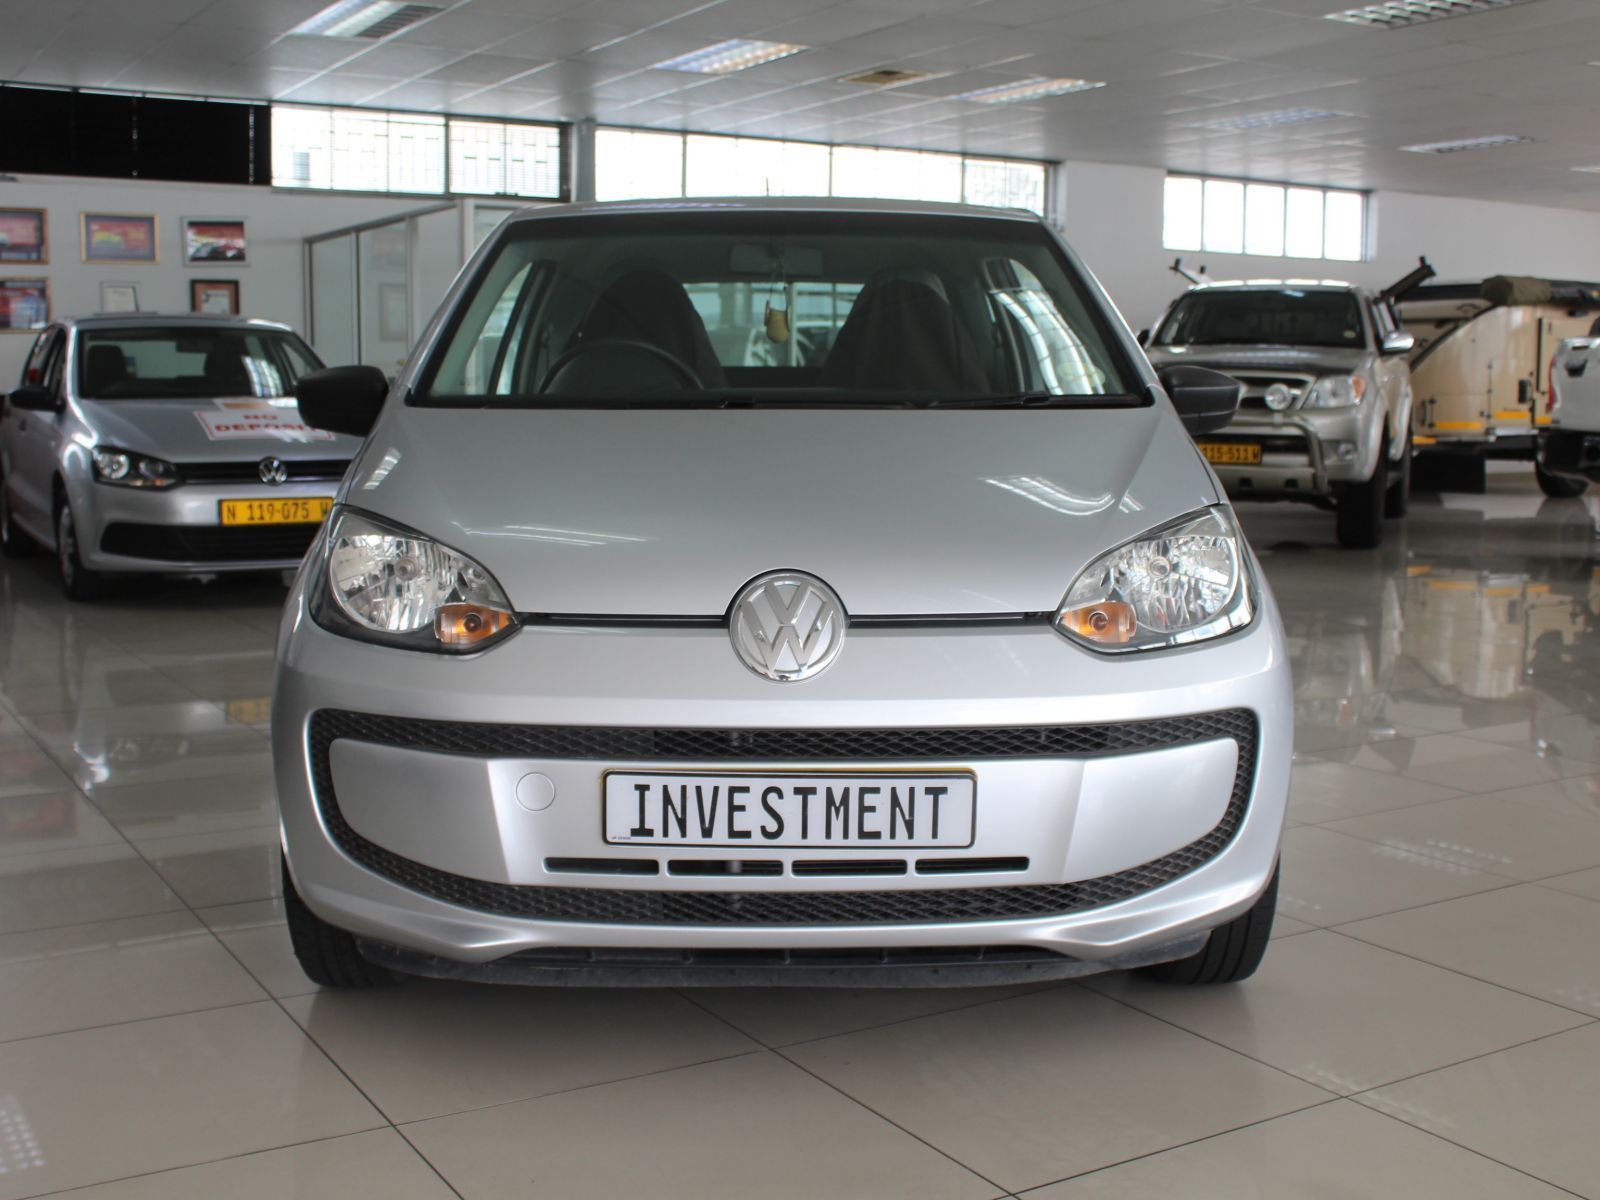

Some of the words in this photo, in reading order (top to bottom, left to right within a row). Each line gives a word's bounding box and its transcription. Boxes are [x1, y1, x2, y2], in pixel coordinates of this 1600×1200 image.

[226, 504, 236, 521] N
[247, 502, 310, 521] 119-075
[630, 784, 948, 840] INVESTMENT
